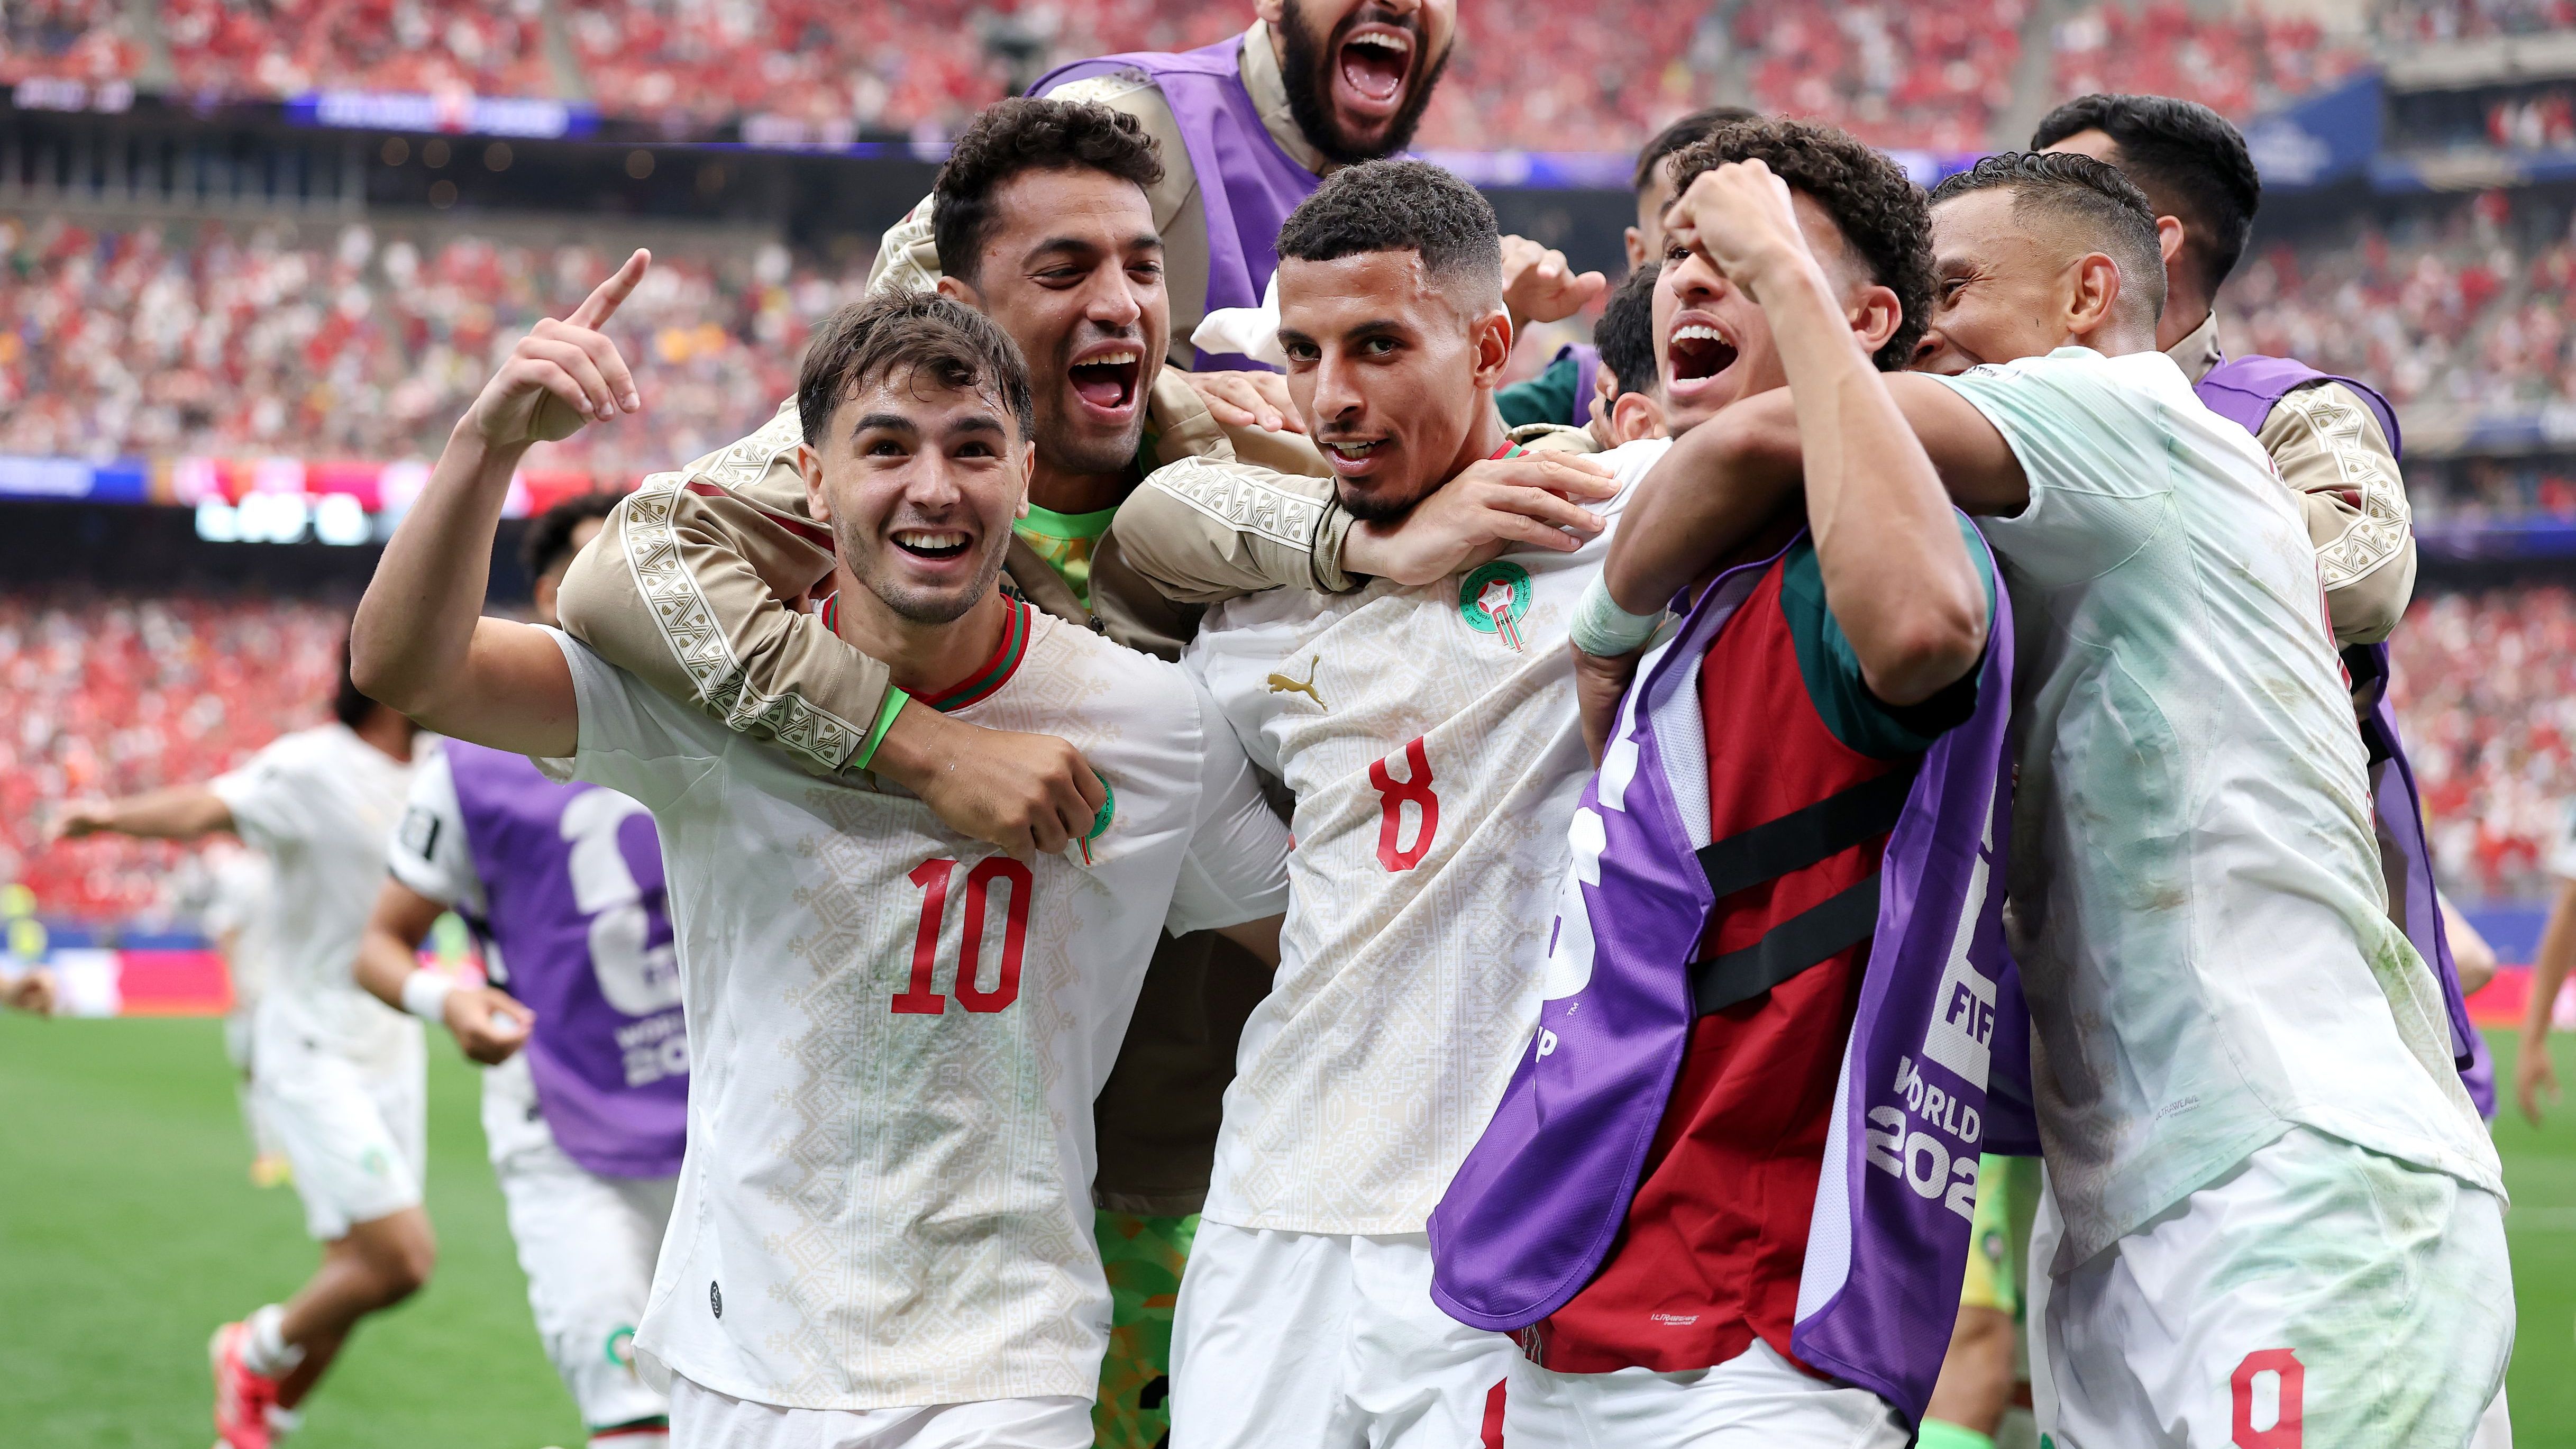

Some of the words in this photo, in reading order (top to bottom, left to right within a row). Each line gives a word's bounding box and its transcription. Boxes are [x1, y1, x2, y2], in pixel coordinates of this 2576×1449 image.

[1369, 736, 1438, 872] 8
[891, 857, 1033, 1014] 10
[1536, 1025, 1558, 1063] P
[1566, 1002, 1579, 1016] TM
[1893, 1055, 1980, 1144] WORLD
